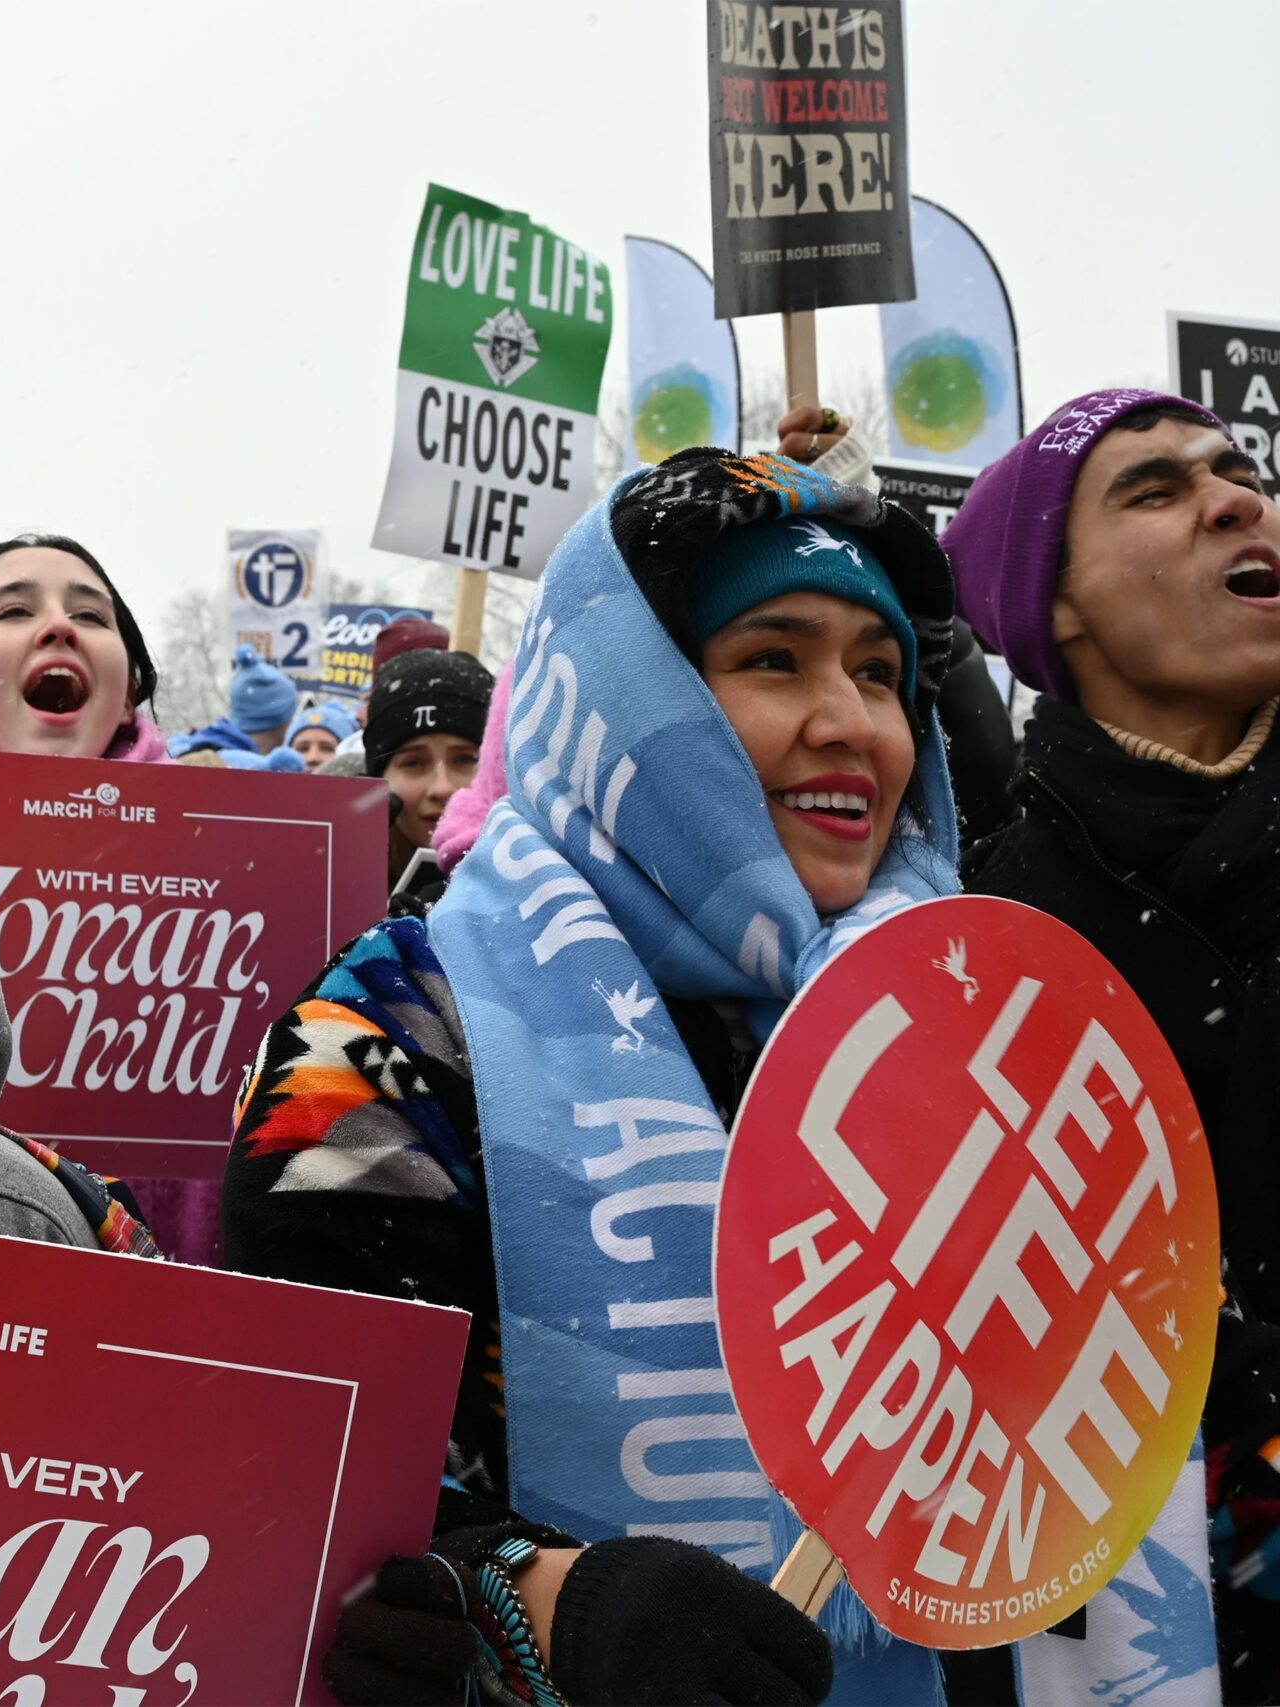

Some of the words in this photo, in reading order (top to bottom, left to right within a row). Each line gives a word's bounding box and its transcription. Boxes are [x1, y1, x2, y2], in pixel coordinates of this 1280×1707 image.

[720, 2, 842, 70] DEATH
[847, 8, 886, 71] IS
[723, 78, 756, 124] NOT
[760, 79, 889, 123] WELCOME
[724, 131, 894, 219] HERE!
[419, 203, 521, 302] LOVE
[528, 233, 606, 324] LIFE
[740, 250, 754, 265] THE
[754, 249, 782, 263] WHITE
[785, 247, 819, 261] ROSE
[822, 242, 881, 258] RESISTANCE
[416, 385, 575, 492] CHOOSE
[442, 479, 530, 570] LIFE
[281, 621, 309, 668] 2
[23, 799, 93, 820] MARCH
[97, 807, 117, 818] FOR
[120, 806, 157, 824] LIFE
[36, 868, 114, 894] WITH
[120, 874, 221, 899] EVERY
[967, 975, 1178, 1265] LET
[796, 992, 1172, 1527] LIFE
[767, 1207, 1046, 1590] HAPPEN
[886, 1537, 1111, 1626] SAVETHESTORKS.ORG
